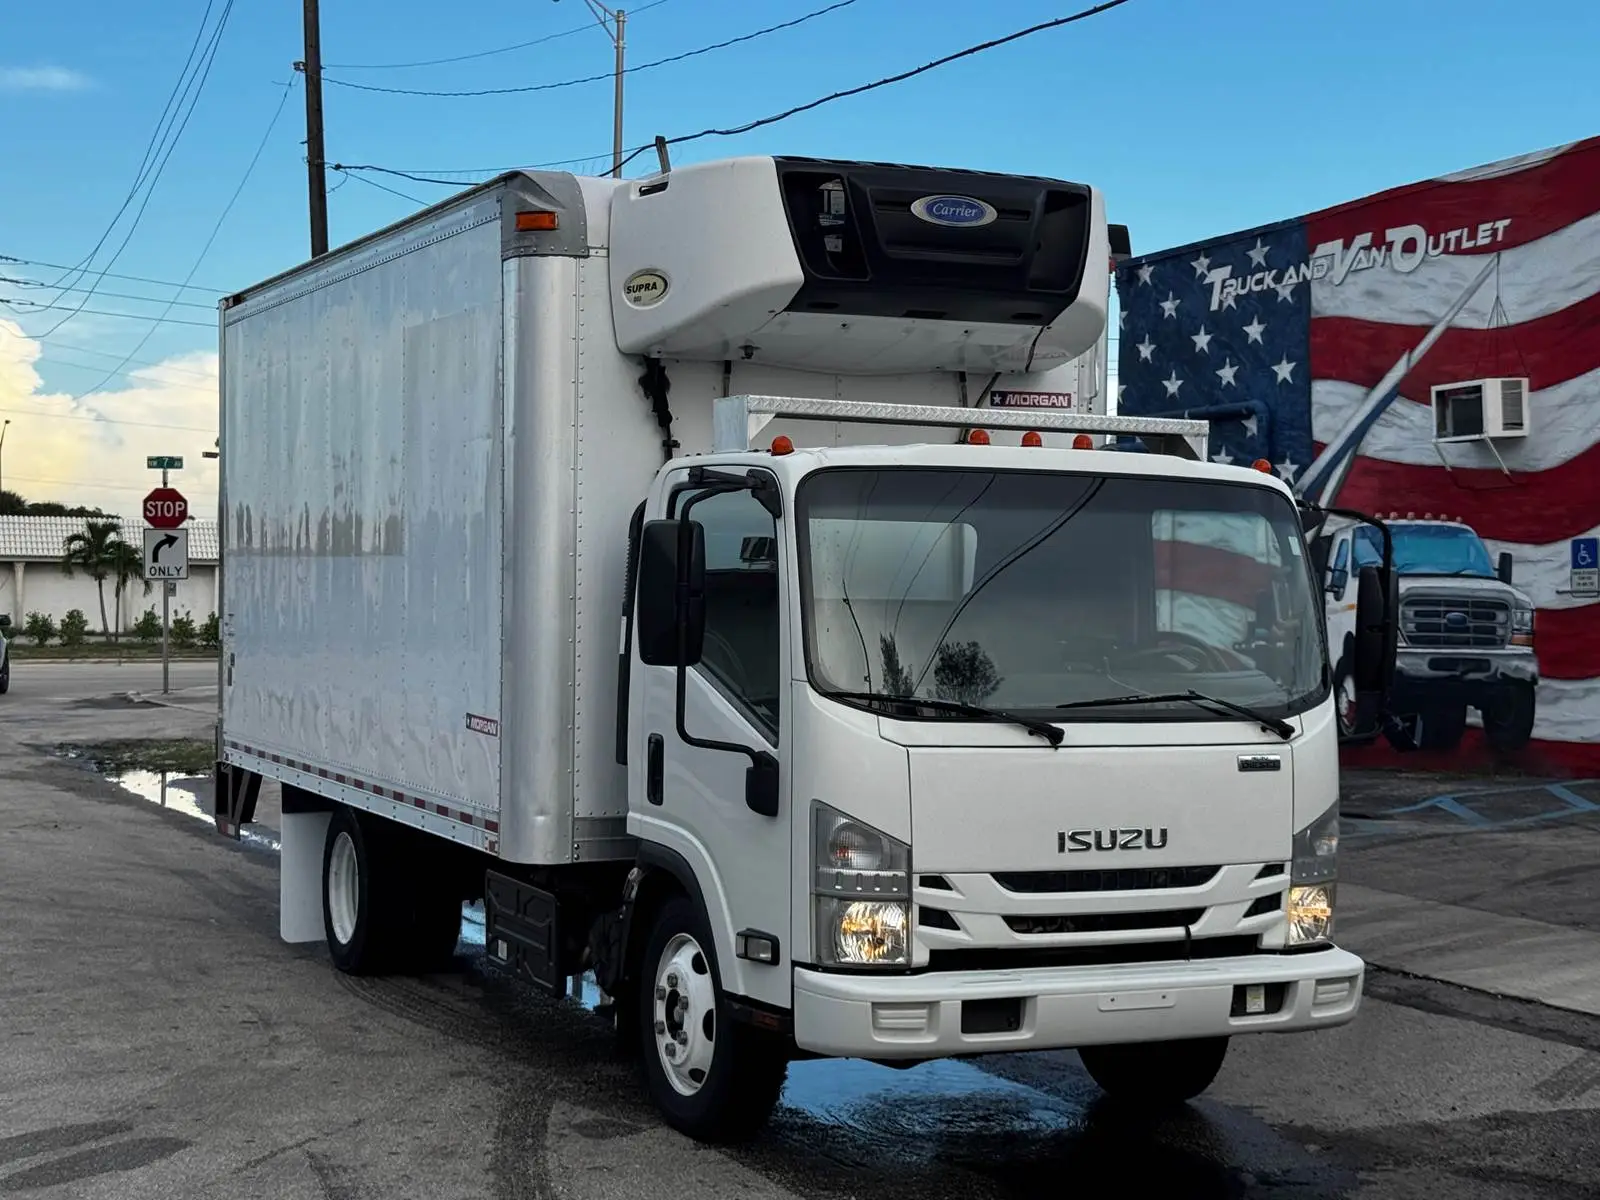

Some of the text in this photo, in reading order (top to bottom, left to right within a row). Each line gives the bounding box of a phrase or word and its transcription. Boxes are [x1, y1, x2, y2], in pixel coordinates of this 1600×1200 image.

[932, 203, 978, 217] Carrier
[1202, 218, 1512, 312] TRUCK AND VAN OUTLET
[626, 281, 658, 295] SUPRA
[1005, 393, 1069, 407] MORGAN
[162, 457, 169, 468] 7
[146, 501, 185, 517] STOP
[149, 566, 183, 577] ONLY
[471, 716, 498, 735] MORGAN
[1057, 827, 1168, 853] ISUZU
